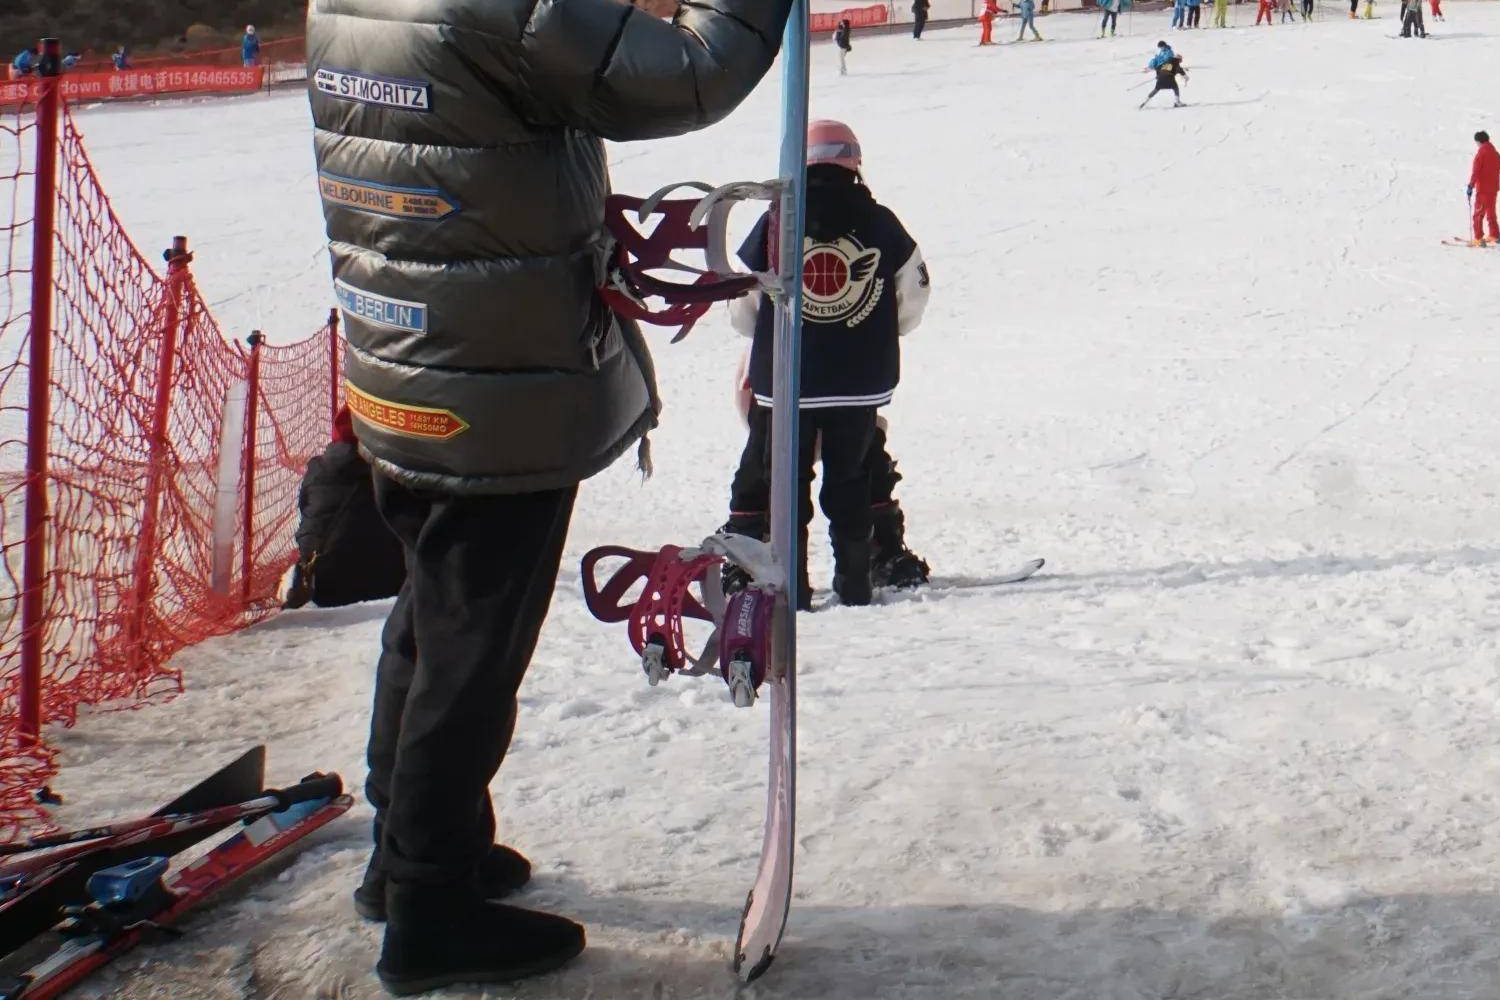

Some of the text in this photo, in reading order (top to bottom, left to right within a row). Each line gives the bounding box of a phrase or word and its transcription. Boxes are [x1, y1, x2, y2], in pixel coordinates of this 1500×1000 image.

[340, 75, 424, 107] ST.MORITZ
[355, 294, 412, 327] BERLIN
[802, 299, 853, 316] ASKETBALL
[359, 398, 406, 427] ANGELES
